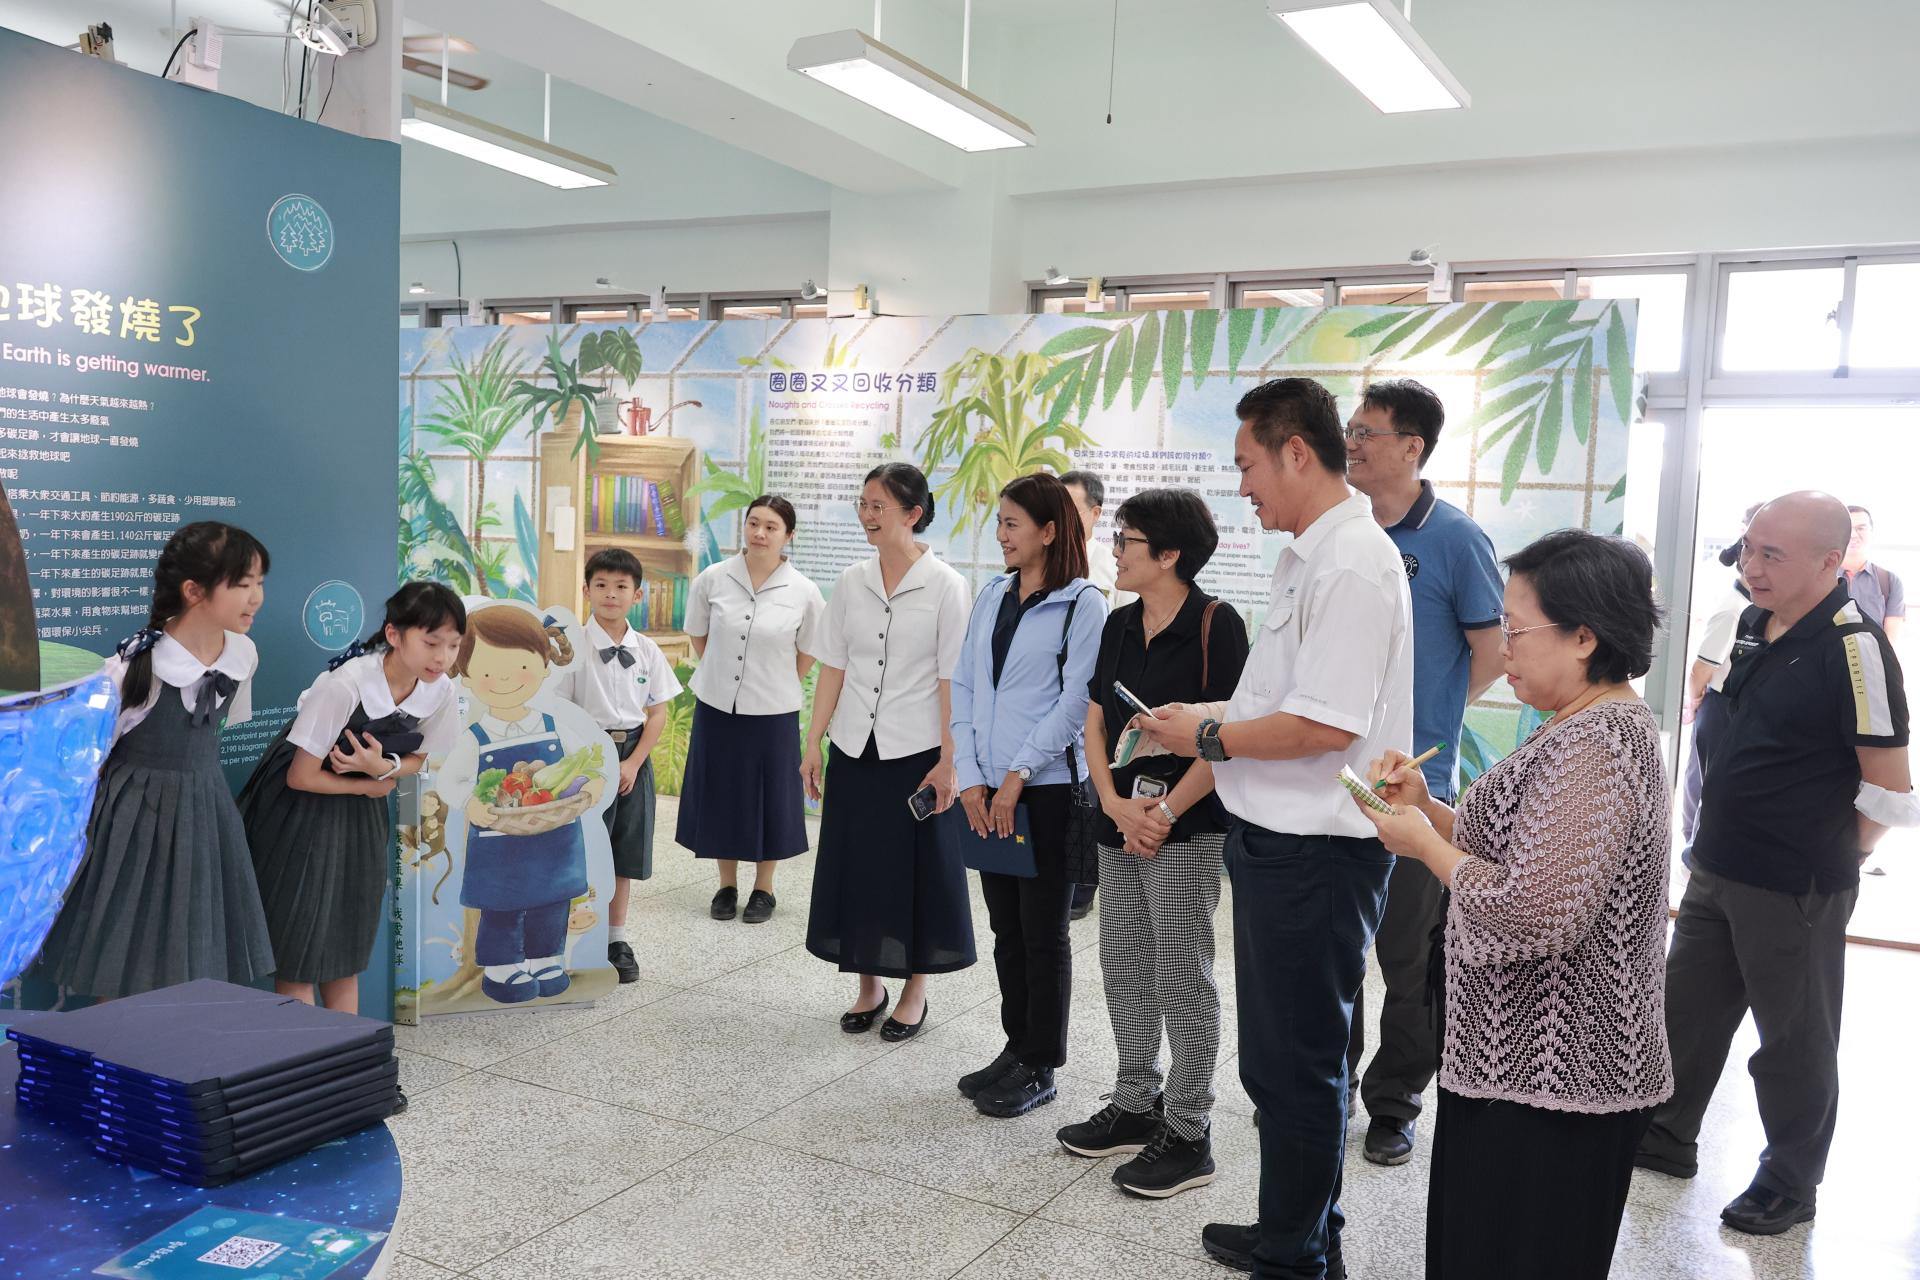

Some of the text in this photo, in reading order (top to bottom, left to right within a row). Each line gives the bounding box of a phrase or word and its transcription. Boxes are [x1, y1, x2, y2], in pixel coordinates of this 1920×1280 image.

[0, 283, 201, 347] 球發燒了
[3, 343, 211, 382] Earth is getting warmer.
[769, 372, 937, 393] 圈圈叉叉回收分類
[768, 401, 799, 409] Noughts
[802, 401, 816, 409] and
[37, 625, 108, 639] 個環保小尖兵。
